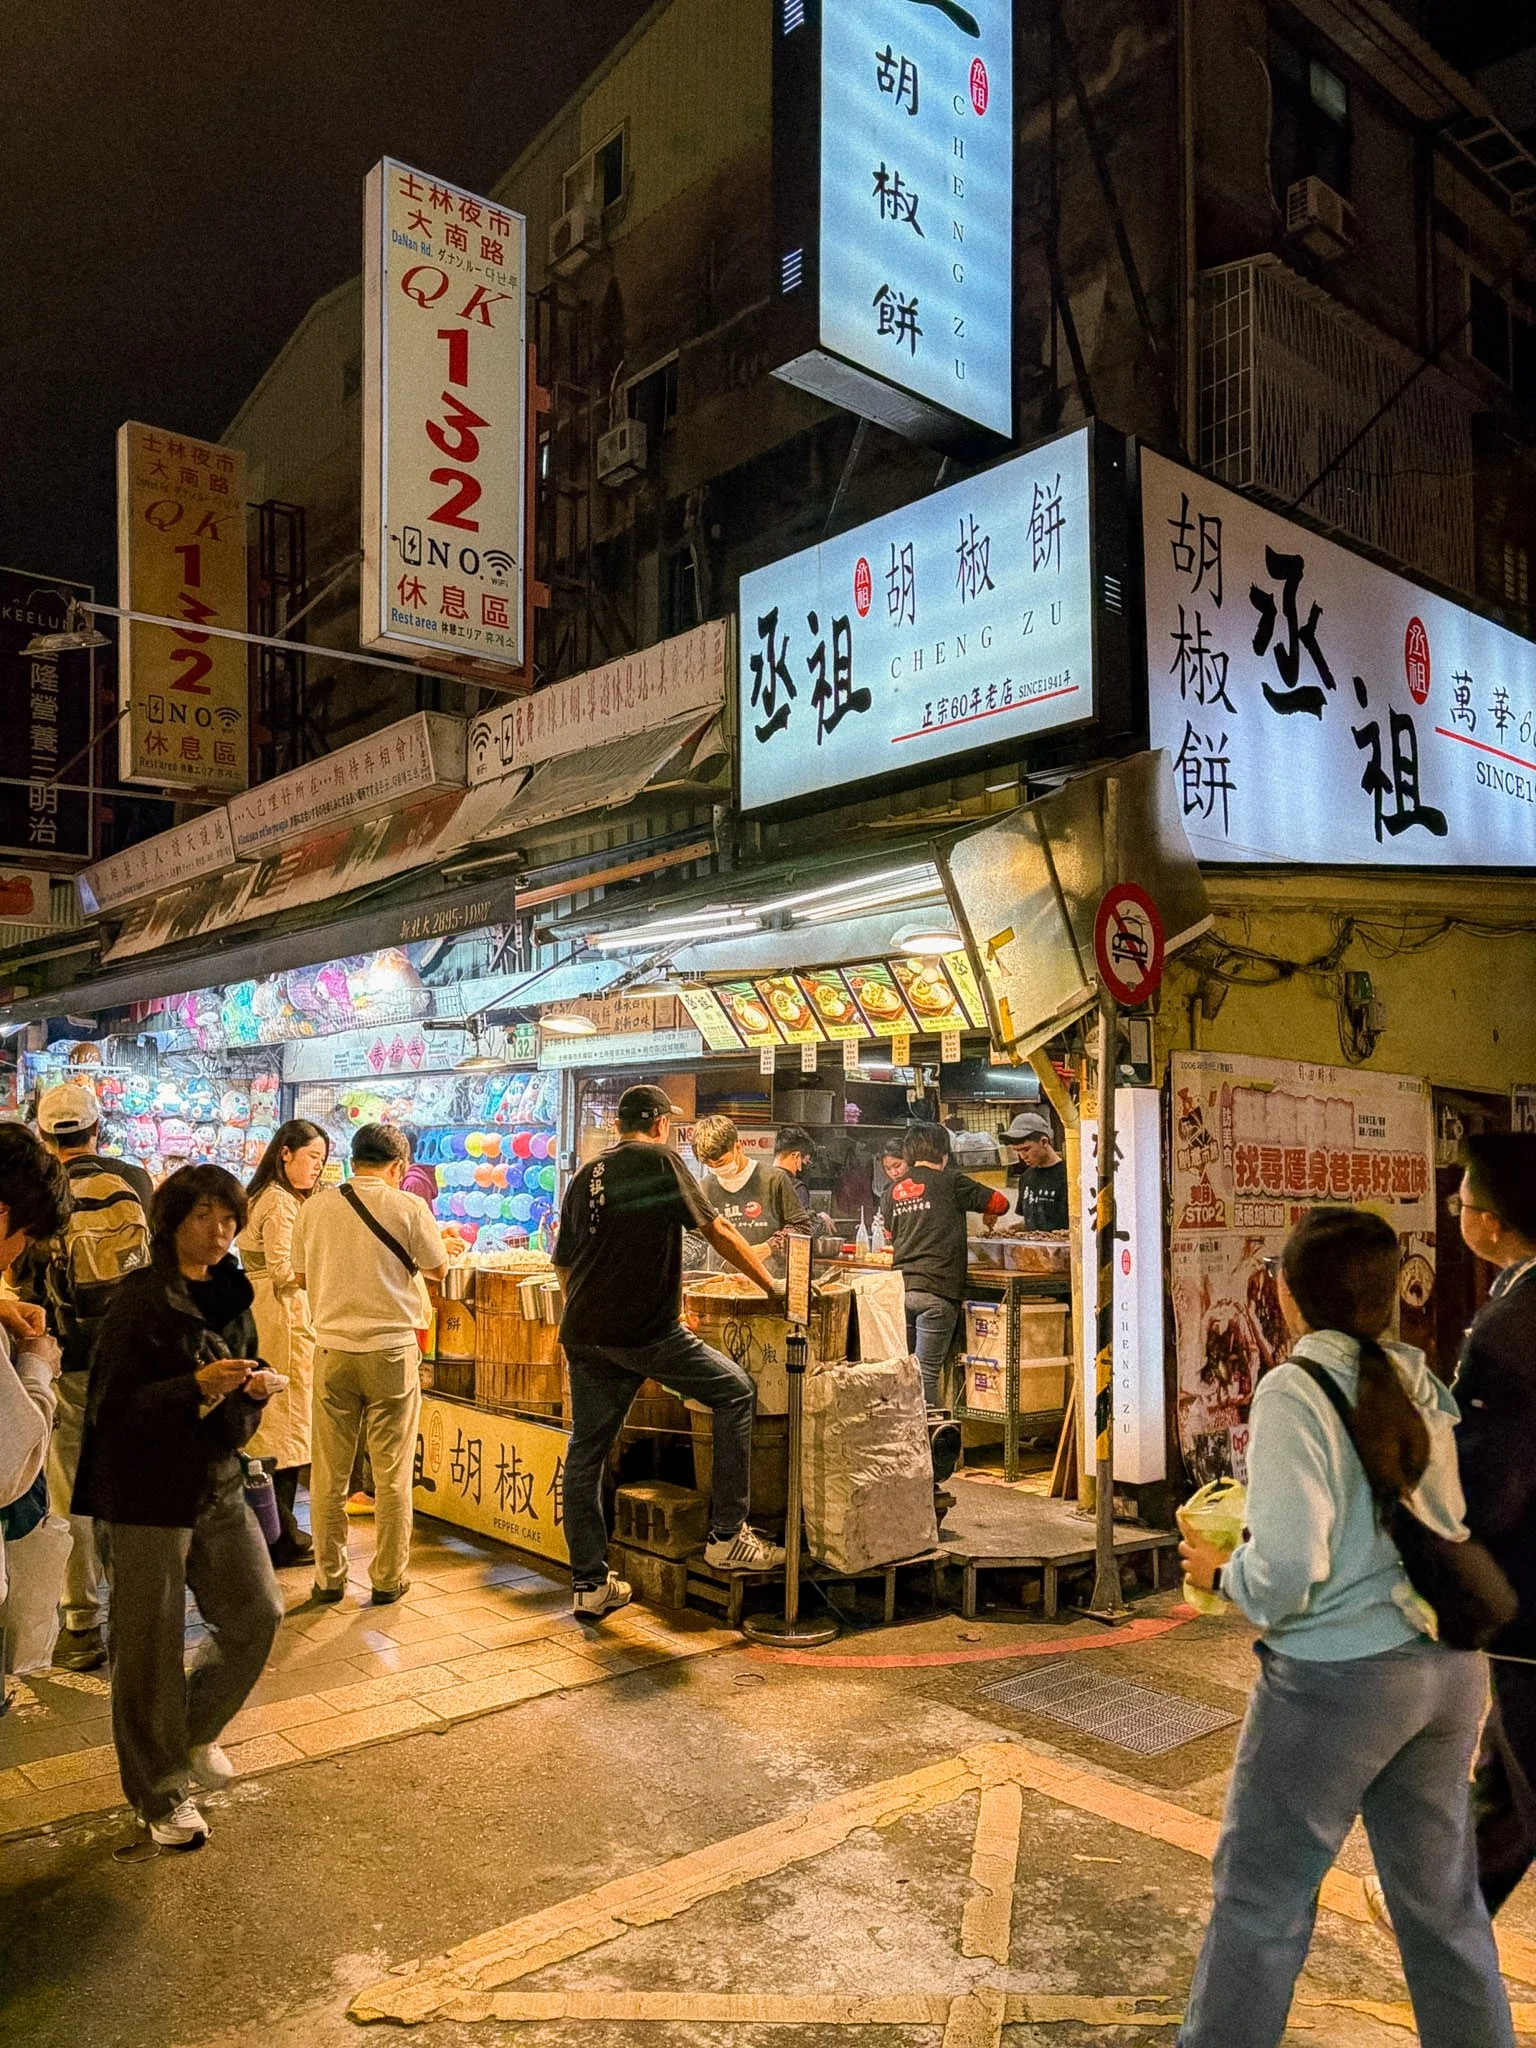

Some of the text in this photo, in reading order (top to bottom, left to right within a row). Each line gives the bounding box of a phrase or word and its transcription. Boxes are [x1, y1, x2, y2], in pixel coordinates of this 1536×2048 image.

[399, 173, 512, 238] 士林夜市
[407, 209, 505, 266] 大南路
[871, 44, 926, 358] 胡椒餅
[952, 95, 966, 380] CHENG ZU
[141, 433, 235, 473] 士林夜市
[425, 328, 492, 533] 1322
[148, 459, 230, 496] 大南路
[885, 473, 1067, 628] 胡椒餅
[2, 606, 86, 632] KEELU
[167, 543, 221, 696] 1322
[396, 573, 511, 629] 休息區
[891, 601, 1063, 680] CHENG ZU
[750, 606, 872, 746] 丞祖
[922, 677, 1013, 728] 正宗60年老店
[1167, 491, 1238, 837] 胡椒餅
[1249, 544, 1449, 843] 丞祖
[28, 632, 60, 846] 隆營養三明治
[143, 729, 238, 767] 休息區
[1449, 669, 1536, 748] 萬華6
[1476, 760, 1536, 803] SINCE1
[1234, 1145, 1429, 1194] 找尋隱身巷弄好滋味
[1120, 1301, 1131, 1434] CHENG ZU
[493, 1517, 542, 1544] PEPPER CAKE
